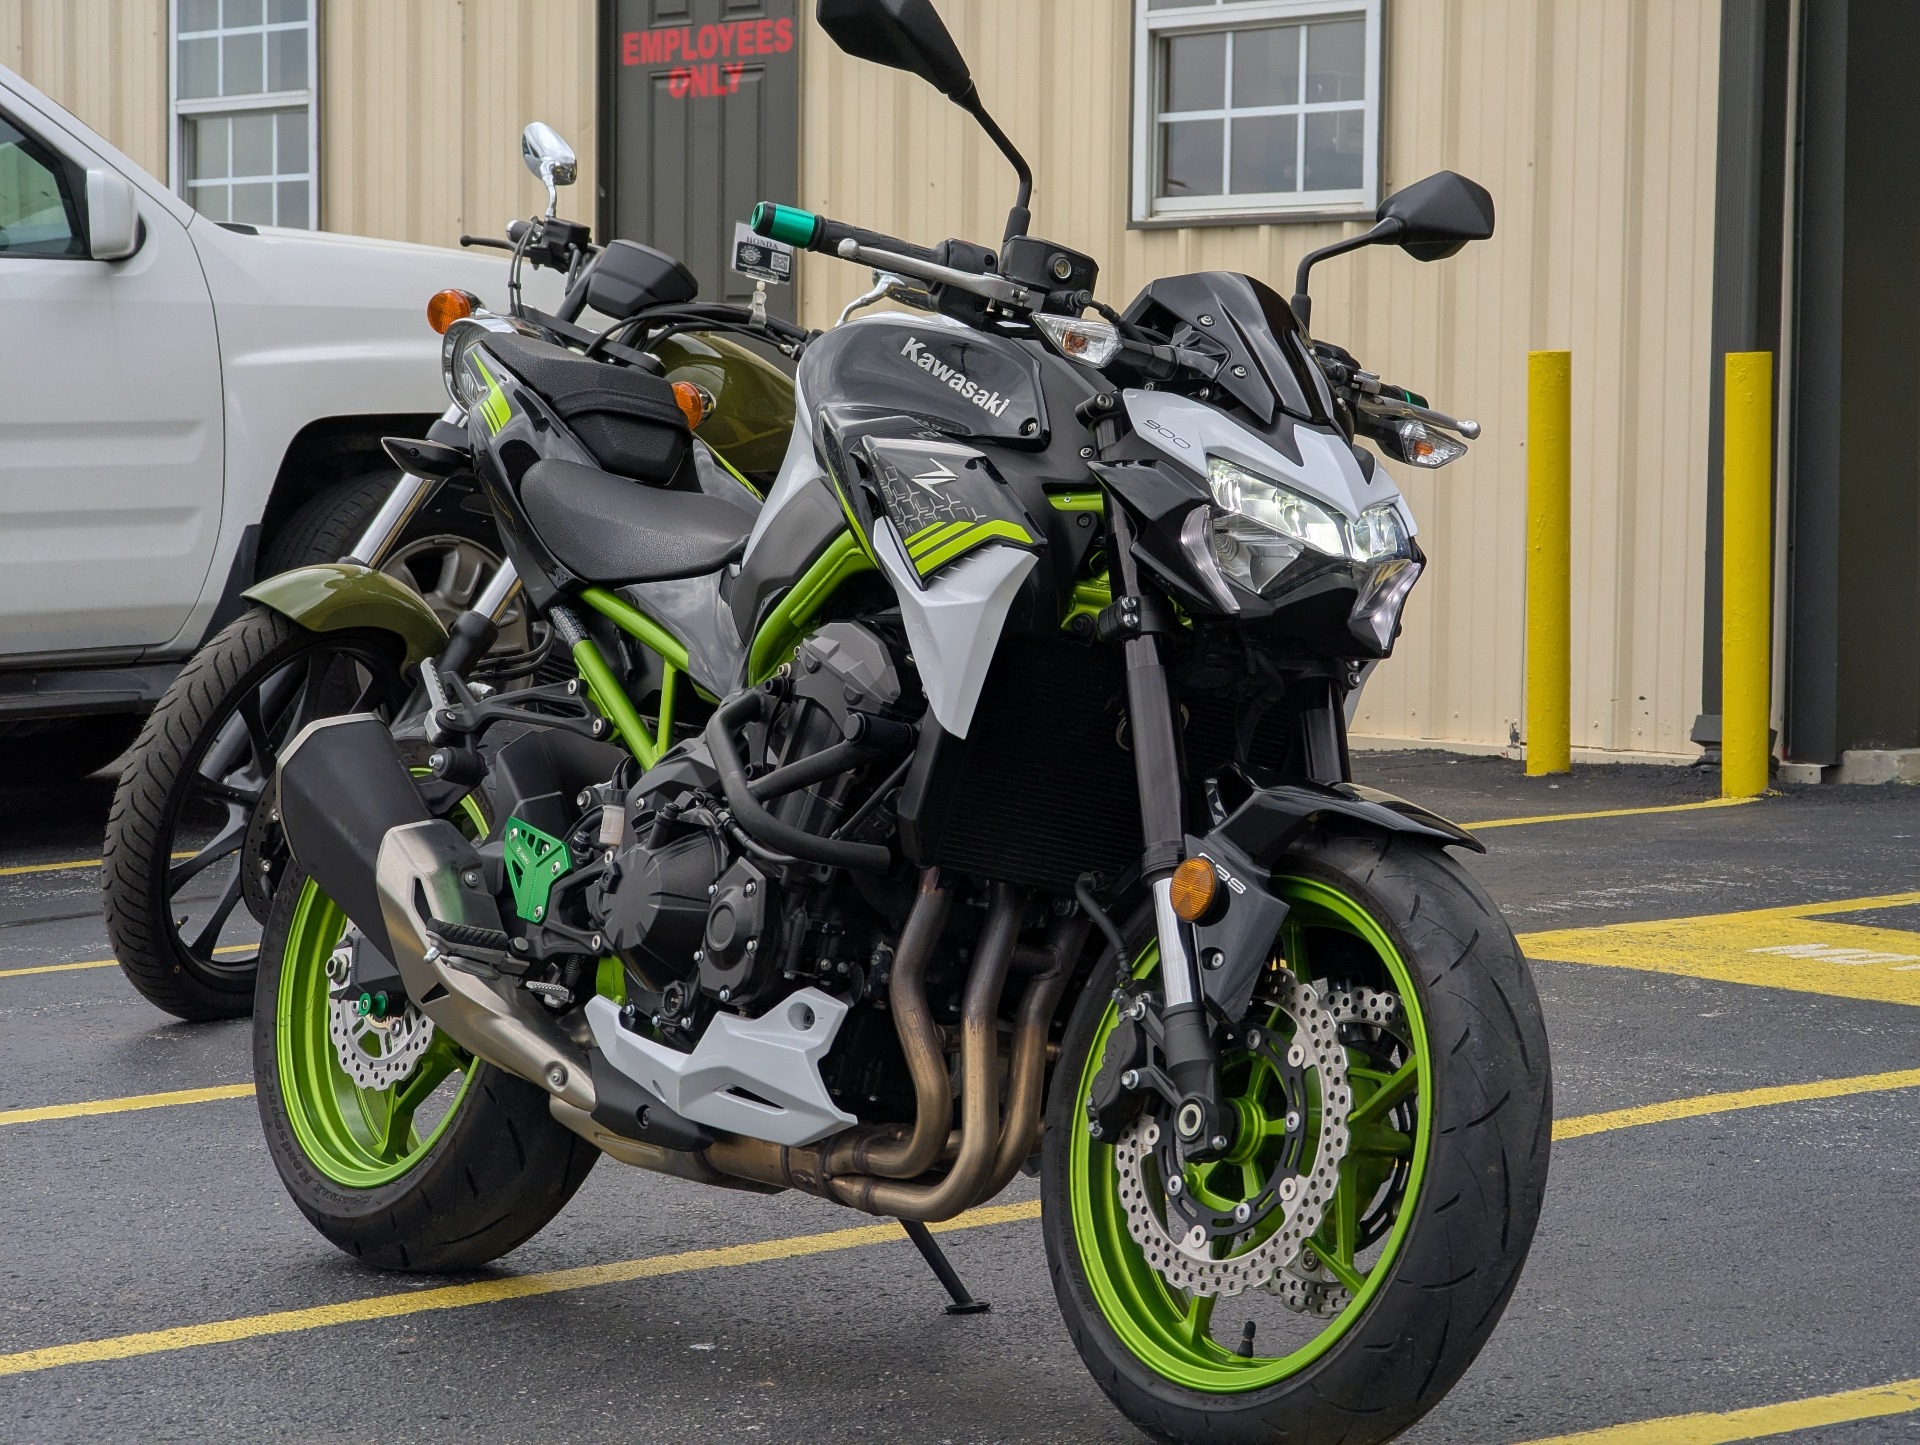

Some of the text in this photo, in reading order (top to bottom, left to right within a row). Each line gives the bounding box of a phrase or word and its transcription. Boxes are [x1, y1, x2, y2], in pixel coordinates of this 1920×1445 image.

[622, 17, 794, 66] EMPLOYEES
[668, 61, 744, 98] ONLY
[746, 236, 779, 250] HONDA
[900, 336, 1011, 418] Kawasaki
[1143, 419, 1191, 449] 900
